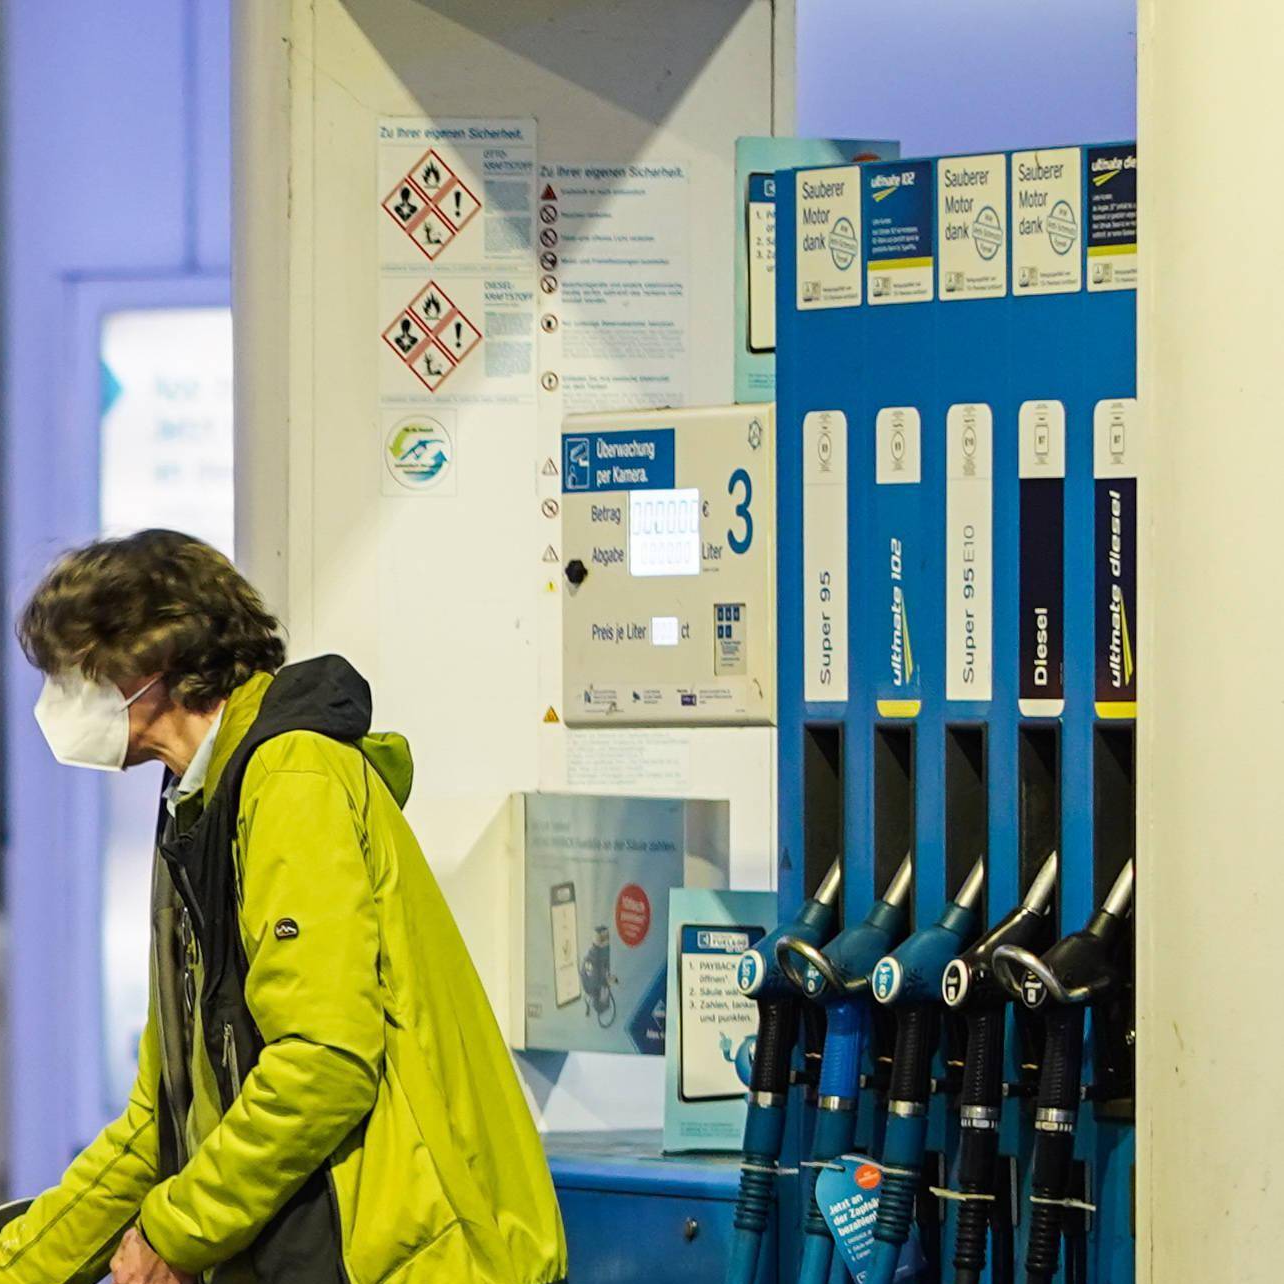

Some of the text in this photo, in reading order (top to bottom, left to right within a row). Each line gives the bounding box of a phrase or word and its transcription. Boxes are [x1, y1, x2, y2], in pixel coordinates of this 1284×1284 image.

[945, 168, 989, 188] Sauberer
[1018, 163, 1064, 182] Sauberer
[802, 181, 845, 200] Sauberer
[1019, 190, 1048, 209] Motor
[945, 197, 974, 214] Motor
[803, 208, 830, 225] Motor
[1019, 215, 1043, 235] dank
[945, 222, 969, 241] dank
[803, 234, 827, 252] dank
[596, 437, 655, 461] Überwachung
[596, 469, 610, 488] per
[591, 504, 621, 526] Betrag
[727, 468, 754, 555] 3
[591, 546, 624, 564] Abgabe
[702, 544, 723, 560] Liter
[1109, 490, 1122, 688] ultimate diesel
[891, 538, 903, 687] ultimate 102
[963, 524, 976, 685] Super 95 E10
[592, 622, 690, 644] Preis je Liter ct
[820, 571, 834, 685] Super 95
[1034, 607, 1049, 686] Diesel
[700, 1012, 715, 1022] und
[851, 1194, 864, 1205] an
[833, 1212, 848, 1226] der
